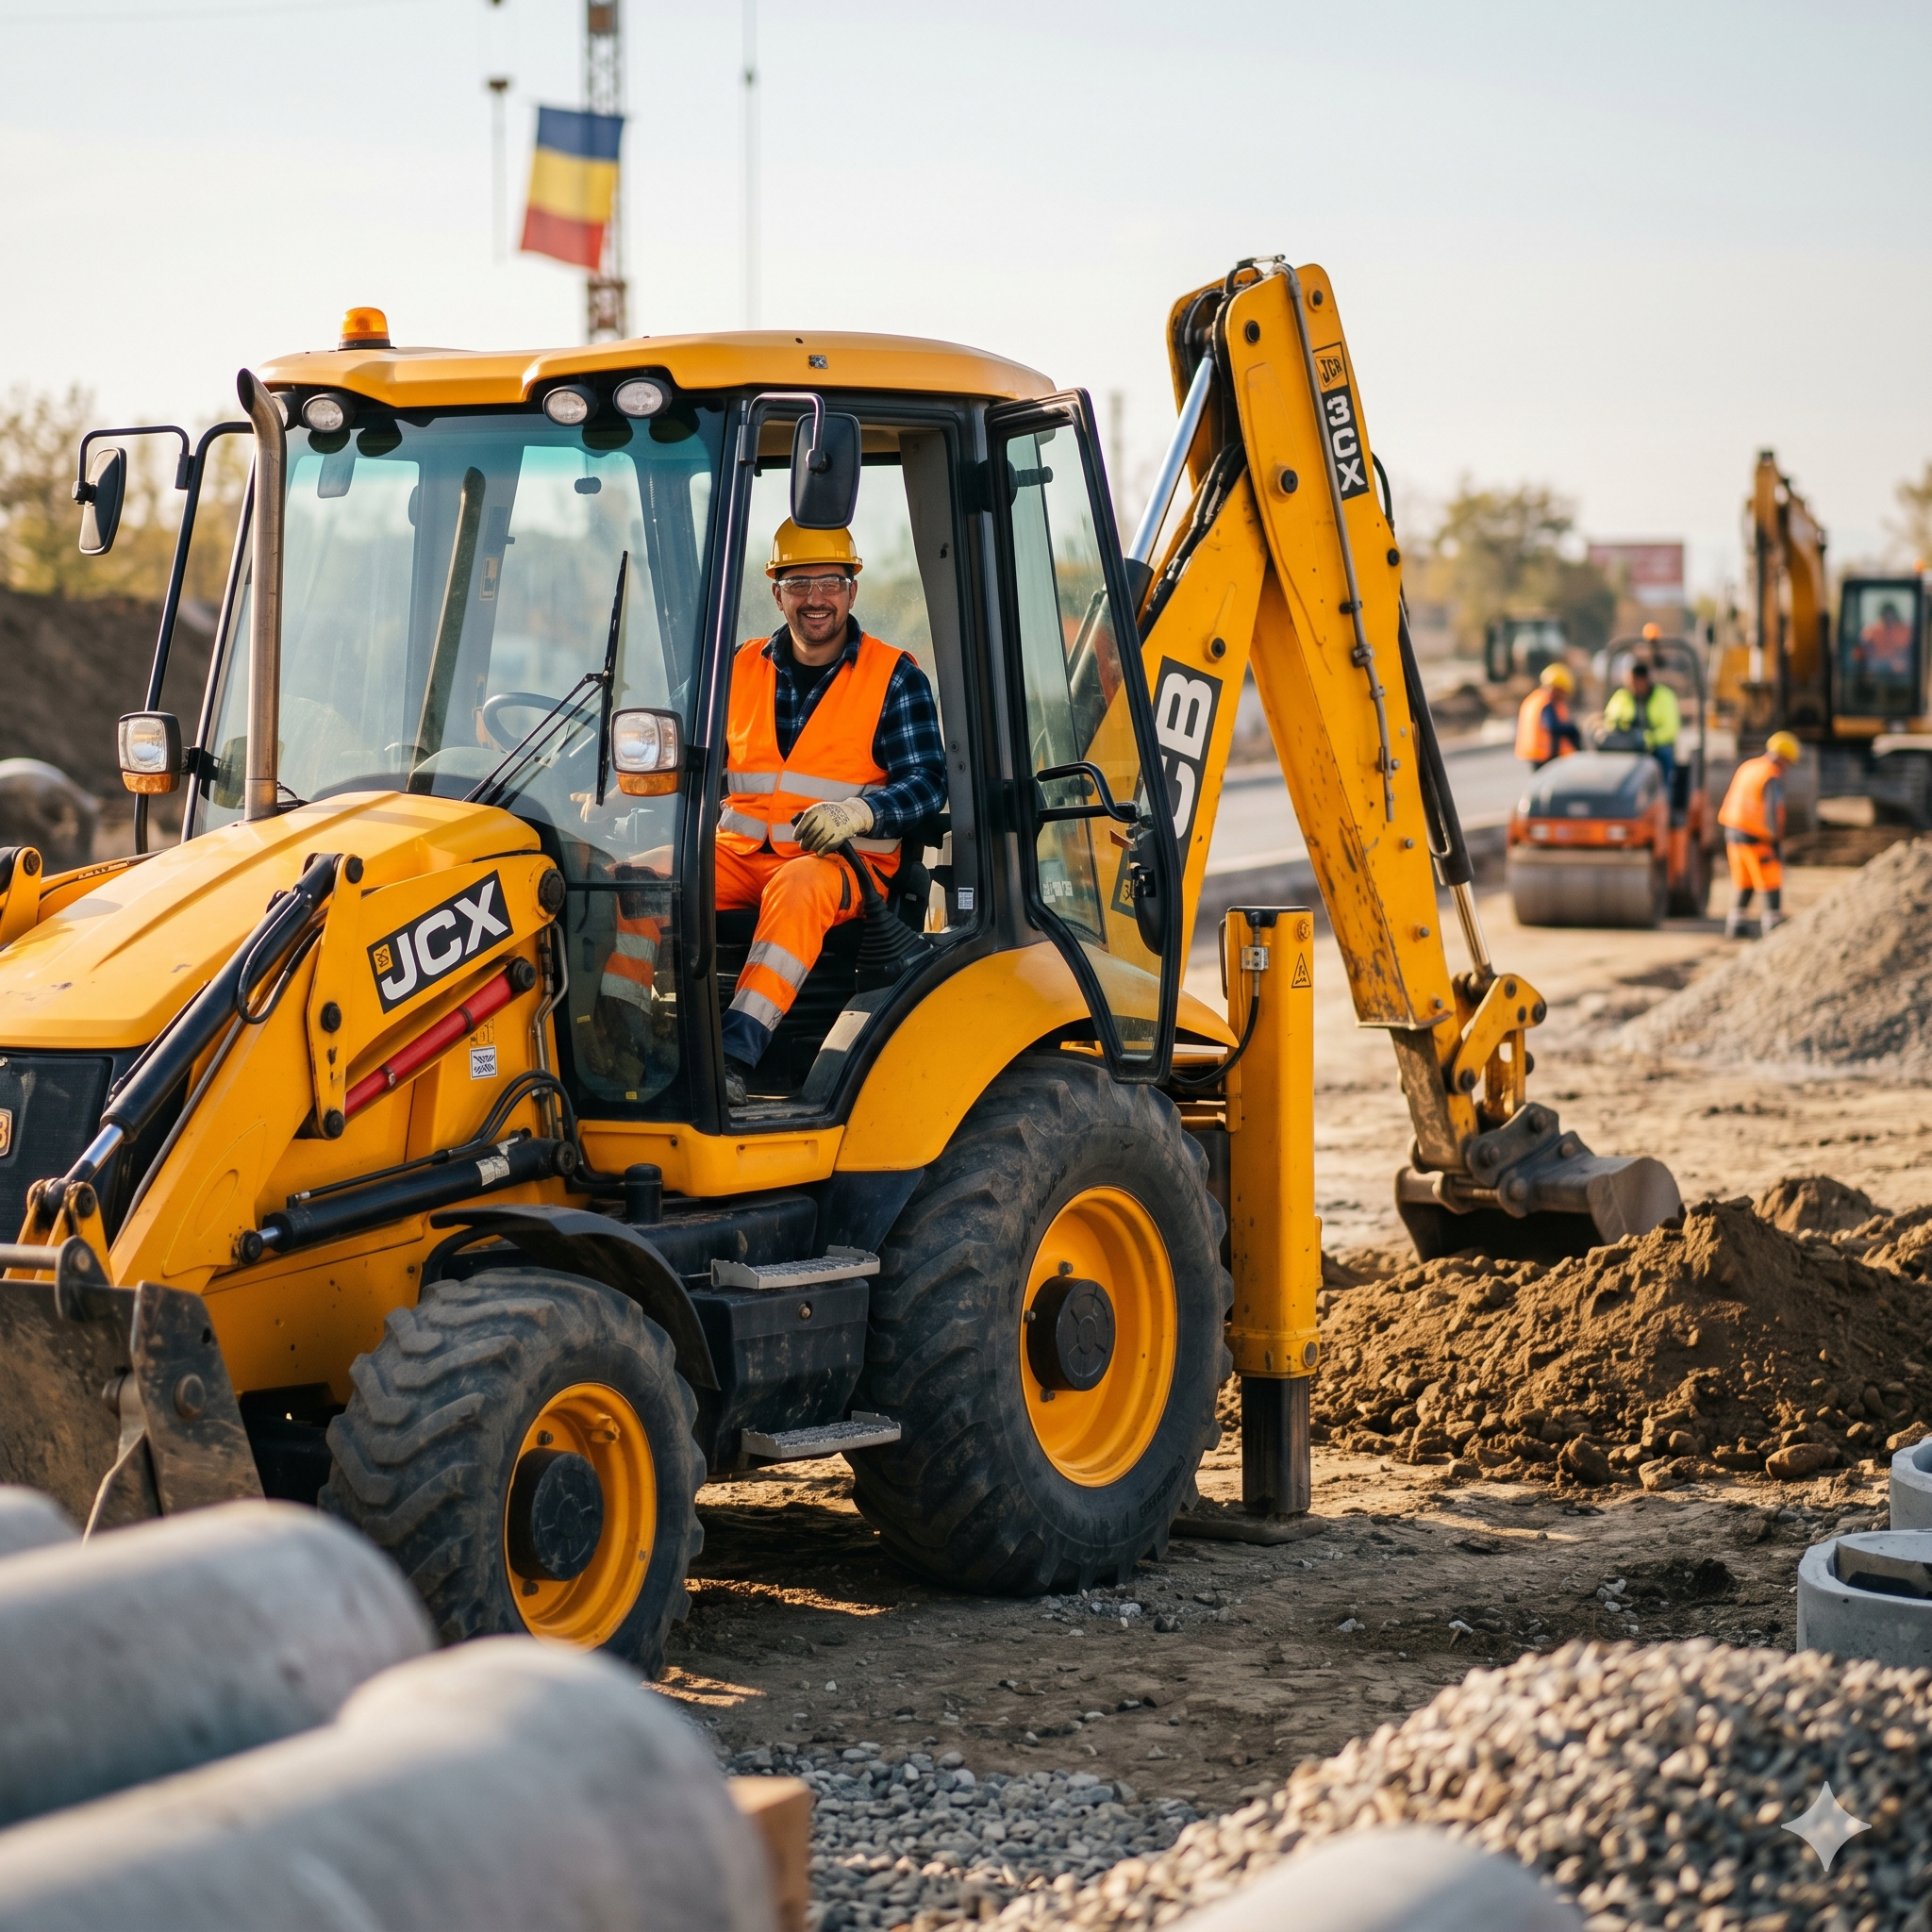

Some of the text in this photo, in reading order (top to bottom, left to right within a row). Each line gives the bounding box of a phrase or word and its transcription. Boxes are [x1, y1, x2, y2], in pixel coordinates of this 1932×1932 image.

[1326, 394, 1366, 492] 3CX
[1147, 673, 1212, 839] CB
[381, 879, 508, 1000] JCX
